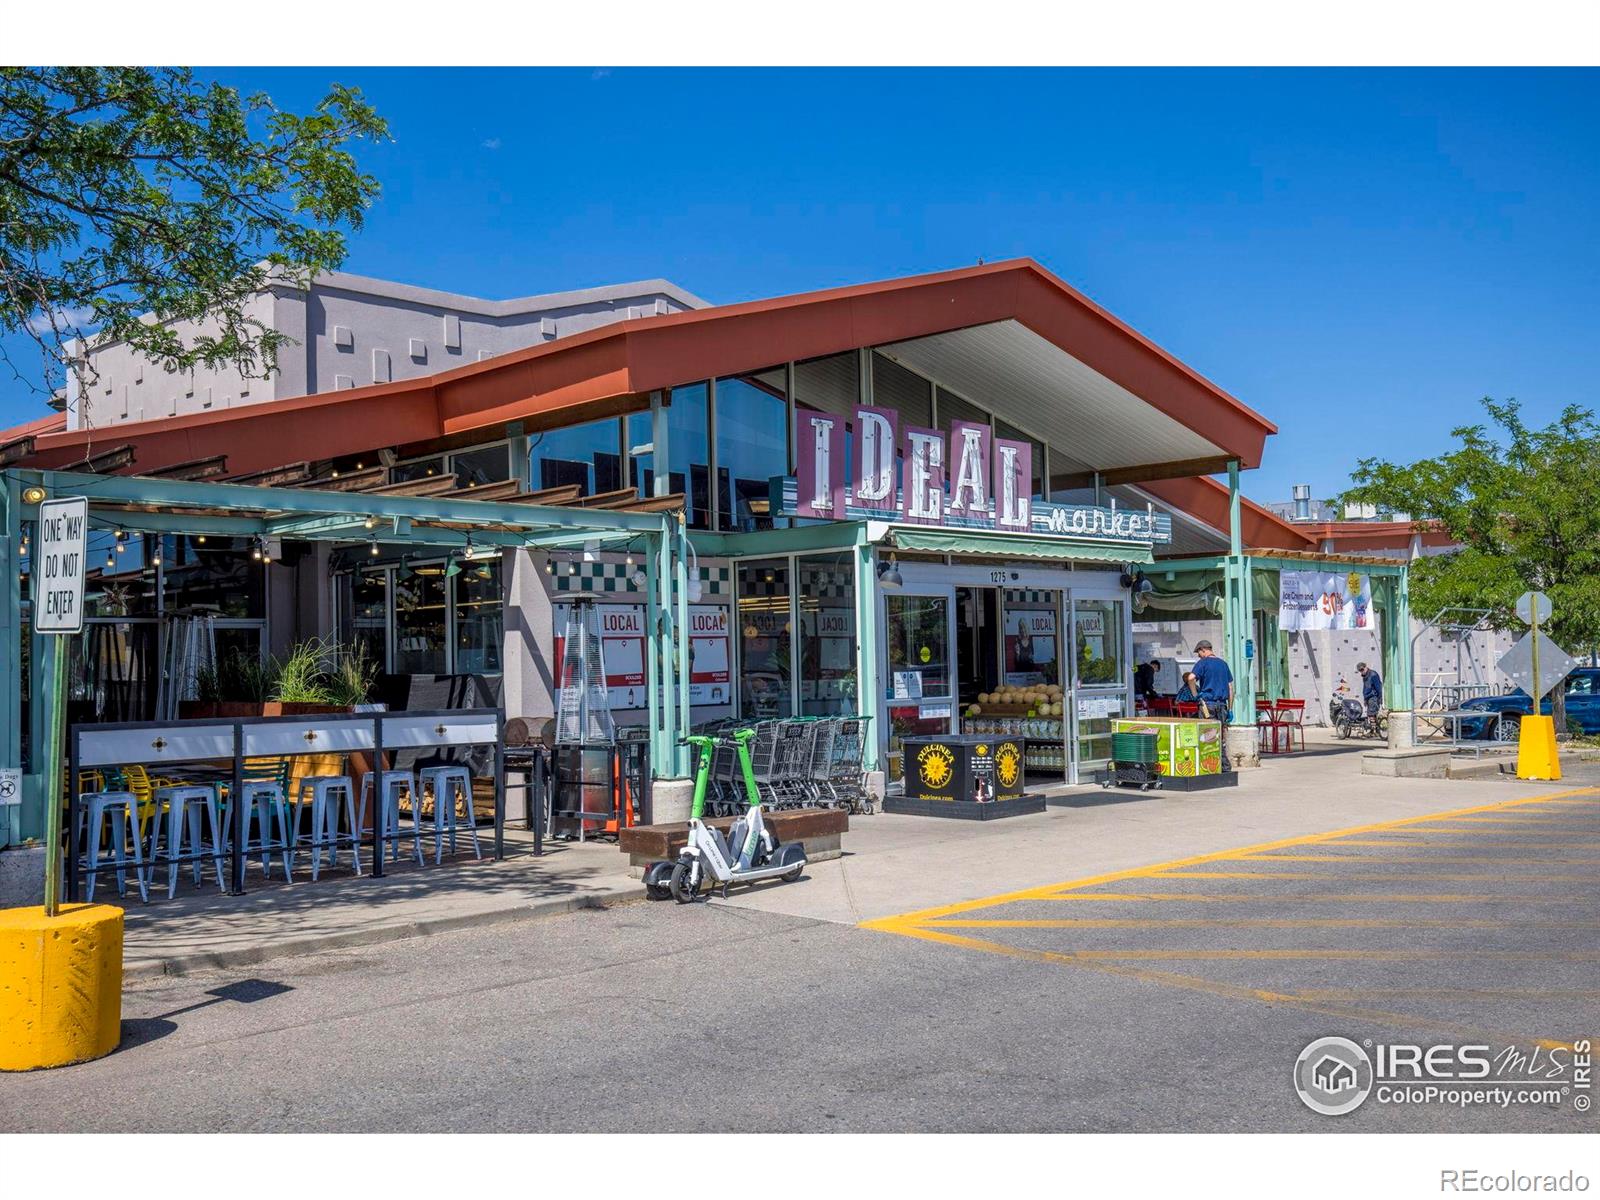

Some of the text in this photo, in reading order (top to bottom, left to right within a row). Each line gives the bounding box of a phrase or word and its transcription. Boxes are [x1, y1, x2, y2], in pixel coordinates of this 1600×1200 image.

[810, 410, 1029, 528] IDEAL
[1047, 498, 1155, 538] market
[43, 516, 83, 542] ONE WAY
[45, 553, 79, 578] DO NOT
[990, 572, 1007, 583] 1275
[47, 590, 74, 615] ENTER
[603, 615, 640, 631] LOCAL
[691, 615, 725, 631] LOCAL
[1031, 618, 1053, 631] LOCAL
[1083, 618, 1102, 631] LOCAL
[917, 744, 955, 764] DULCINEA
[995, 742, 1021, 762] DULCINEA
